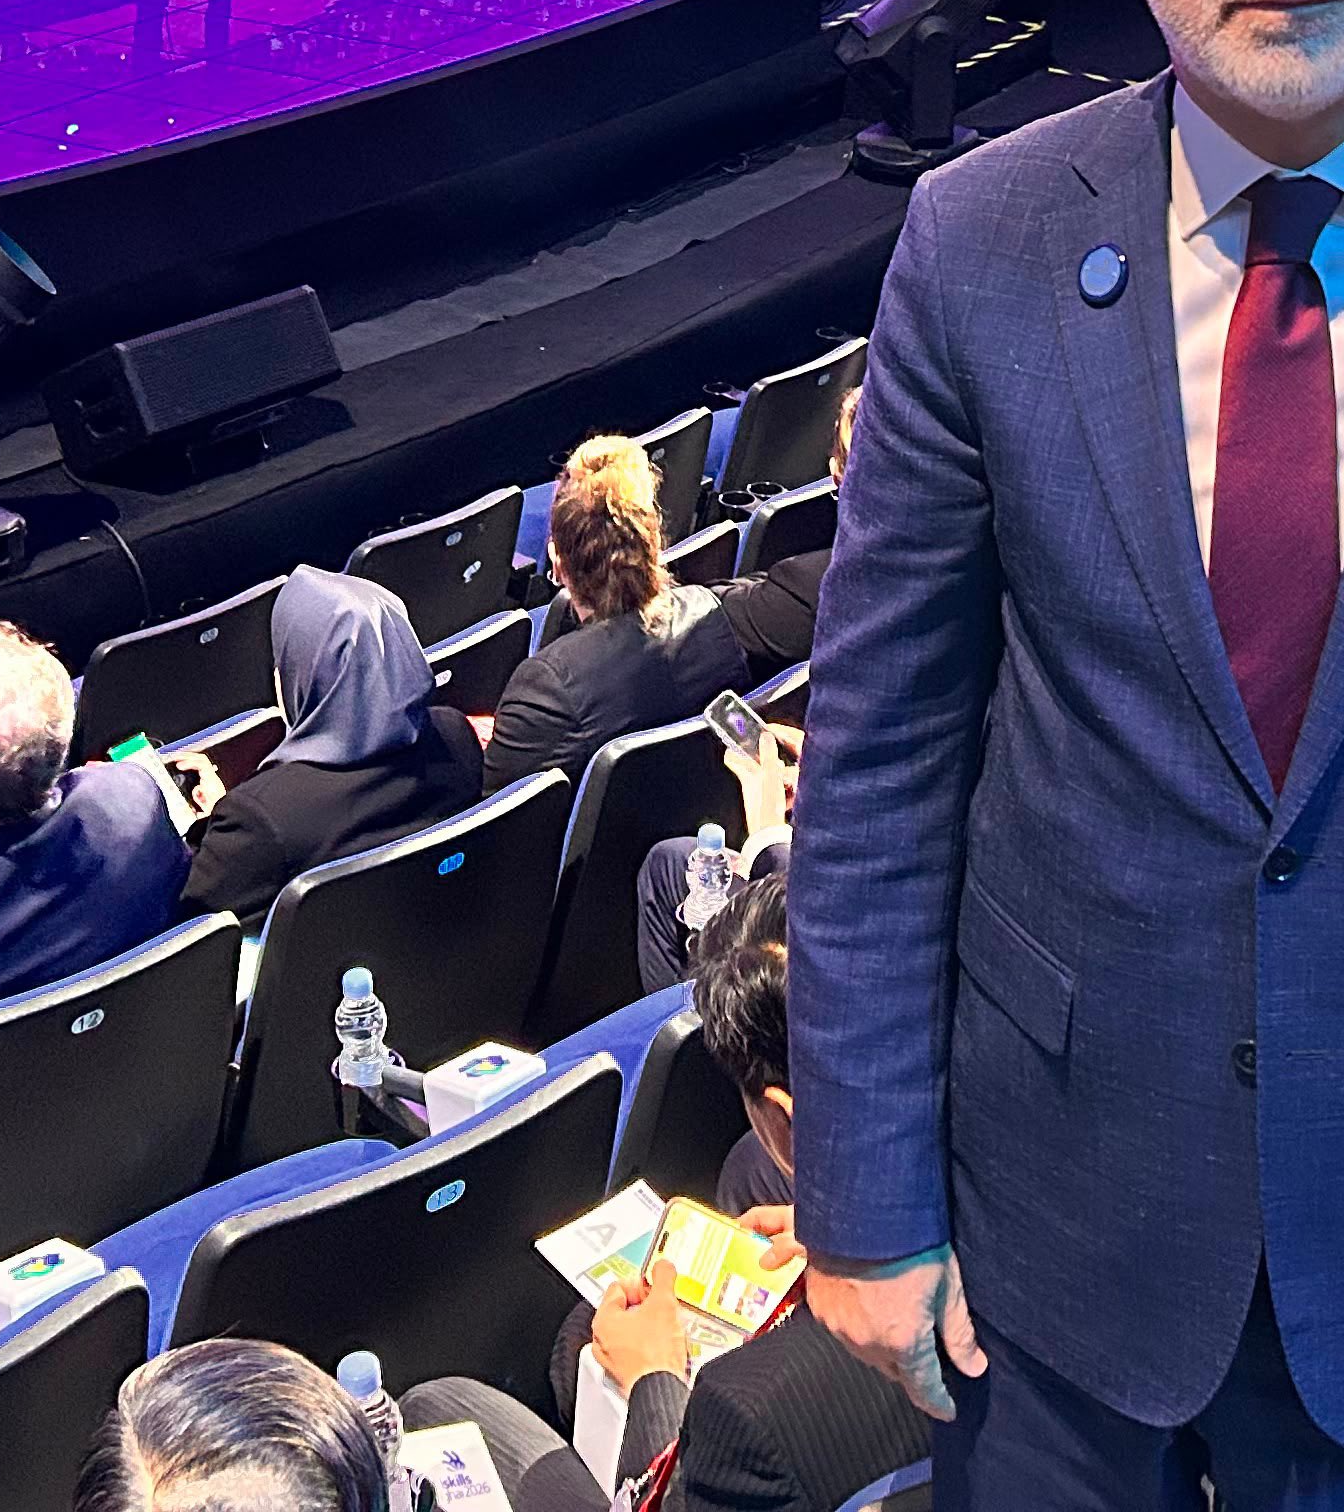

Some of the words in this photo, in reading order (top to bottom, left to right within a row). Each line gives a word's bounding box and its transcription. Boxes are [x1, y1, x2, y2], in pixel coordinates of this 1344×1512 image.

[79, 1013, 97, 1031] 12
[436, 1185, 458, 1206] 13
[439, 1472, 473, 1490] skills
